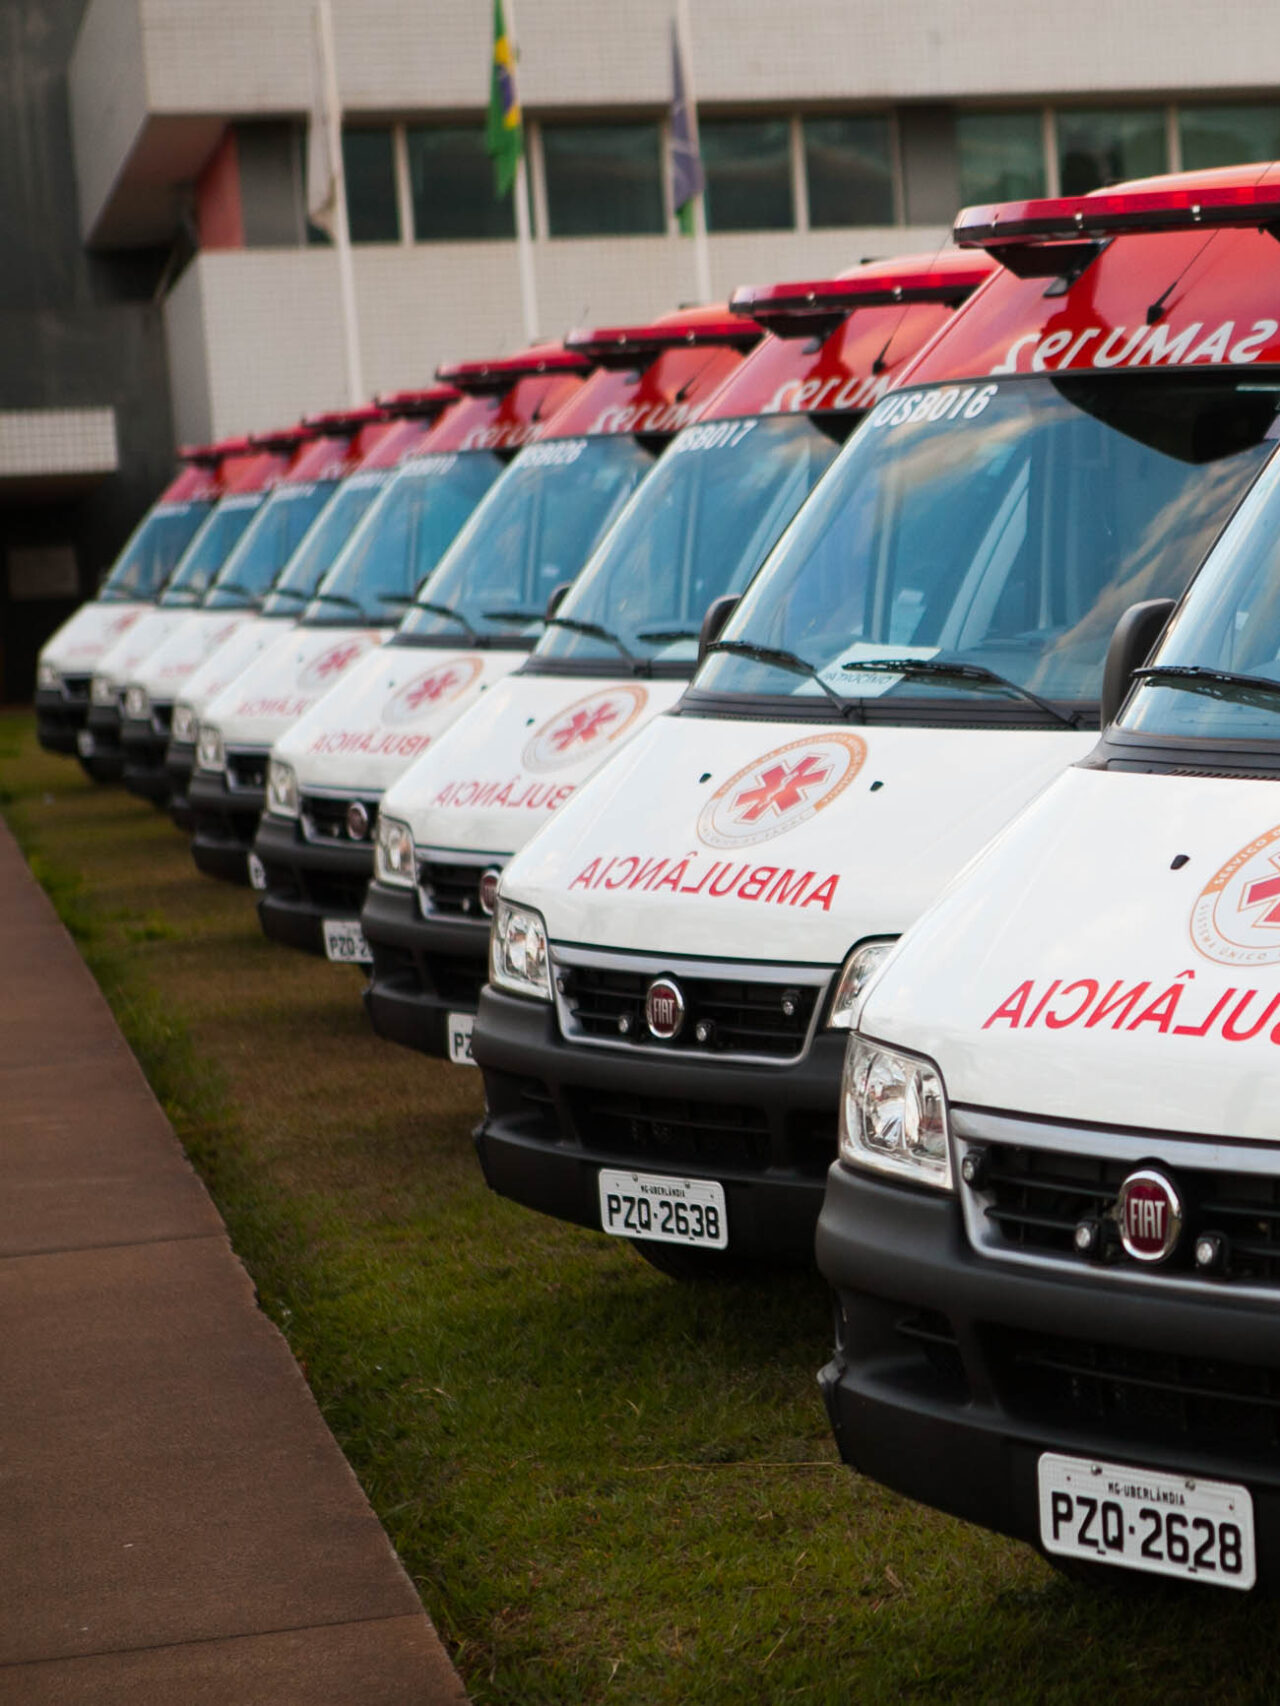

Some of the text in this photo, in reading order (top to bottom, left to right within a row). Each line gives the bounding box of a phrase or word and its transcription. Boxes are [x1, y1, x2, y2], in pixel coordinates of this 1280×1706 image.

[873, 384, 999, 428] USB016
[653, 997, 675, 1025] FIAT
[1130, 1198, 1166, 1240] FIAT
